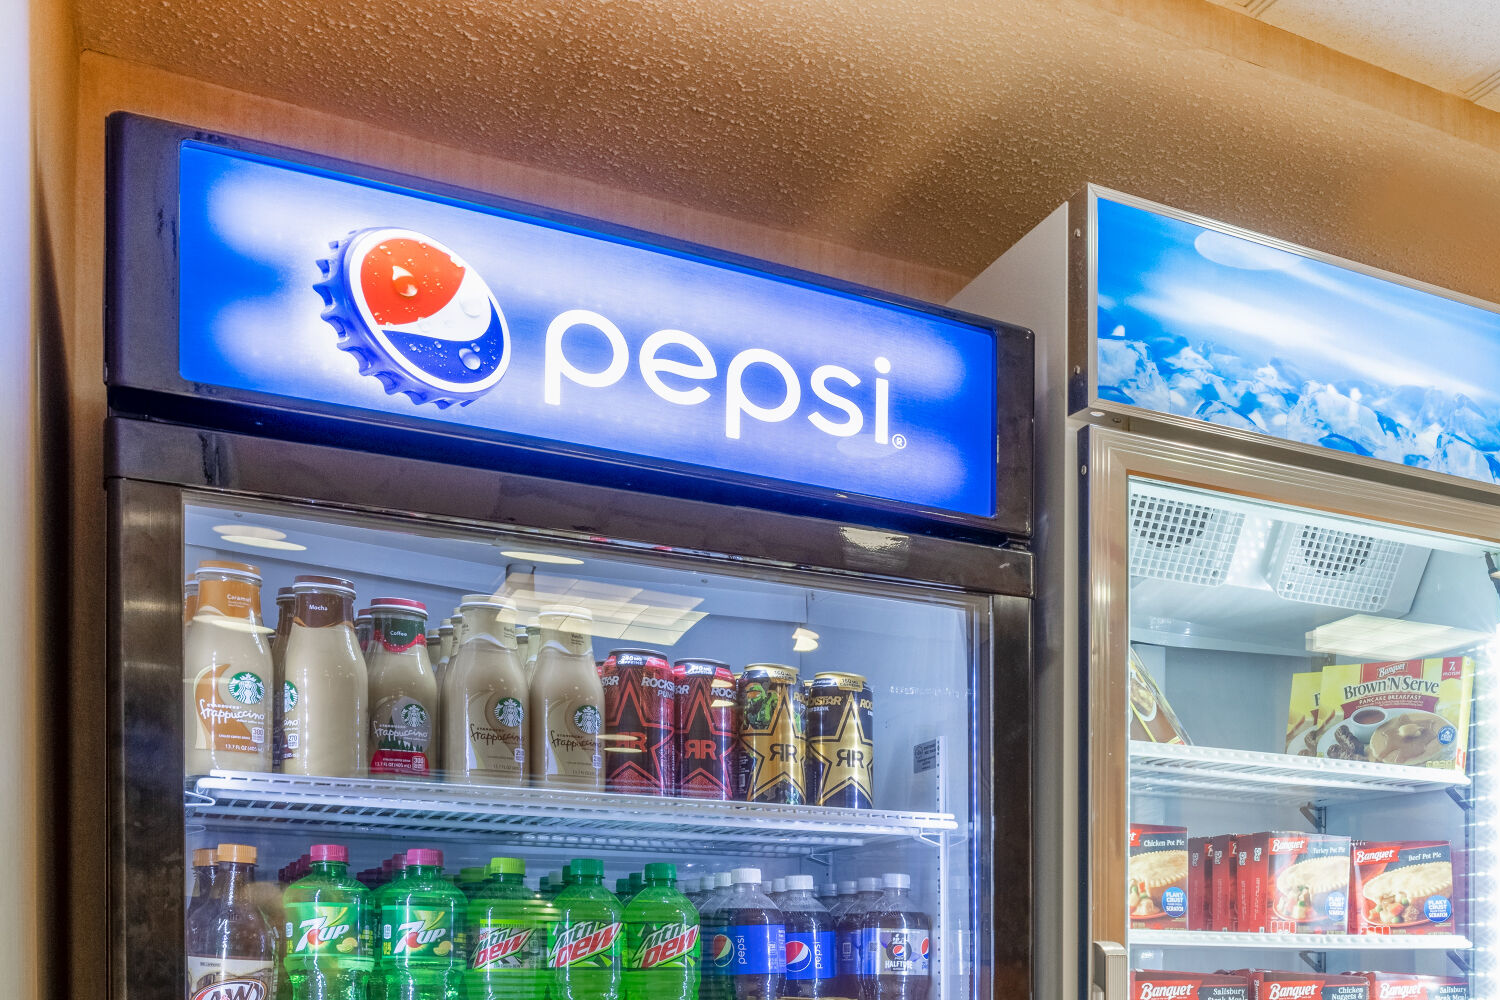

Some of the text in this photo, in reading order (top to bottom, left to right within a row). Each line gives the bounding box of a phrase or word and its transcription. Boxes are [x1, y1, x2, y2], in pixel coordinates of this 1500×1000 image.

[1359, 695, 1383, 705] PANCAKE
[1384, 694, 1422, 702] BREAKFAST
[1272, 840, 1305, 852] Banquet
[1356, 850, 1395, 863] Banquet
[1409, 854, 1421, 862] Beef
[735, 935, 745, 965] pepsi
[1140, 982, 1194, 1000] Banquet
[1213, 988, 1245, 997] Salisbury
[1269, 983, 1318, 1000] Banquet
[1379, 983, 1422, 998] Banquet
